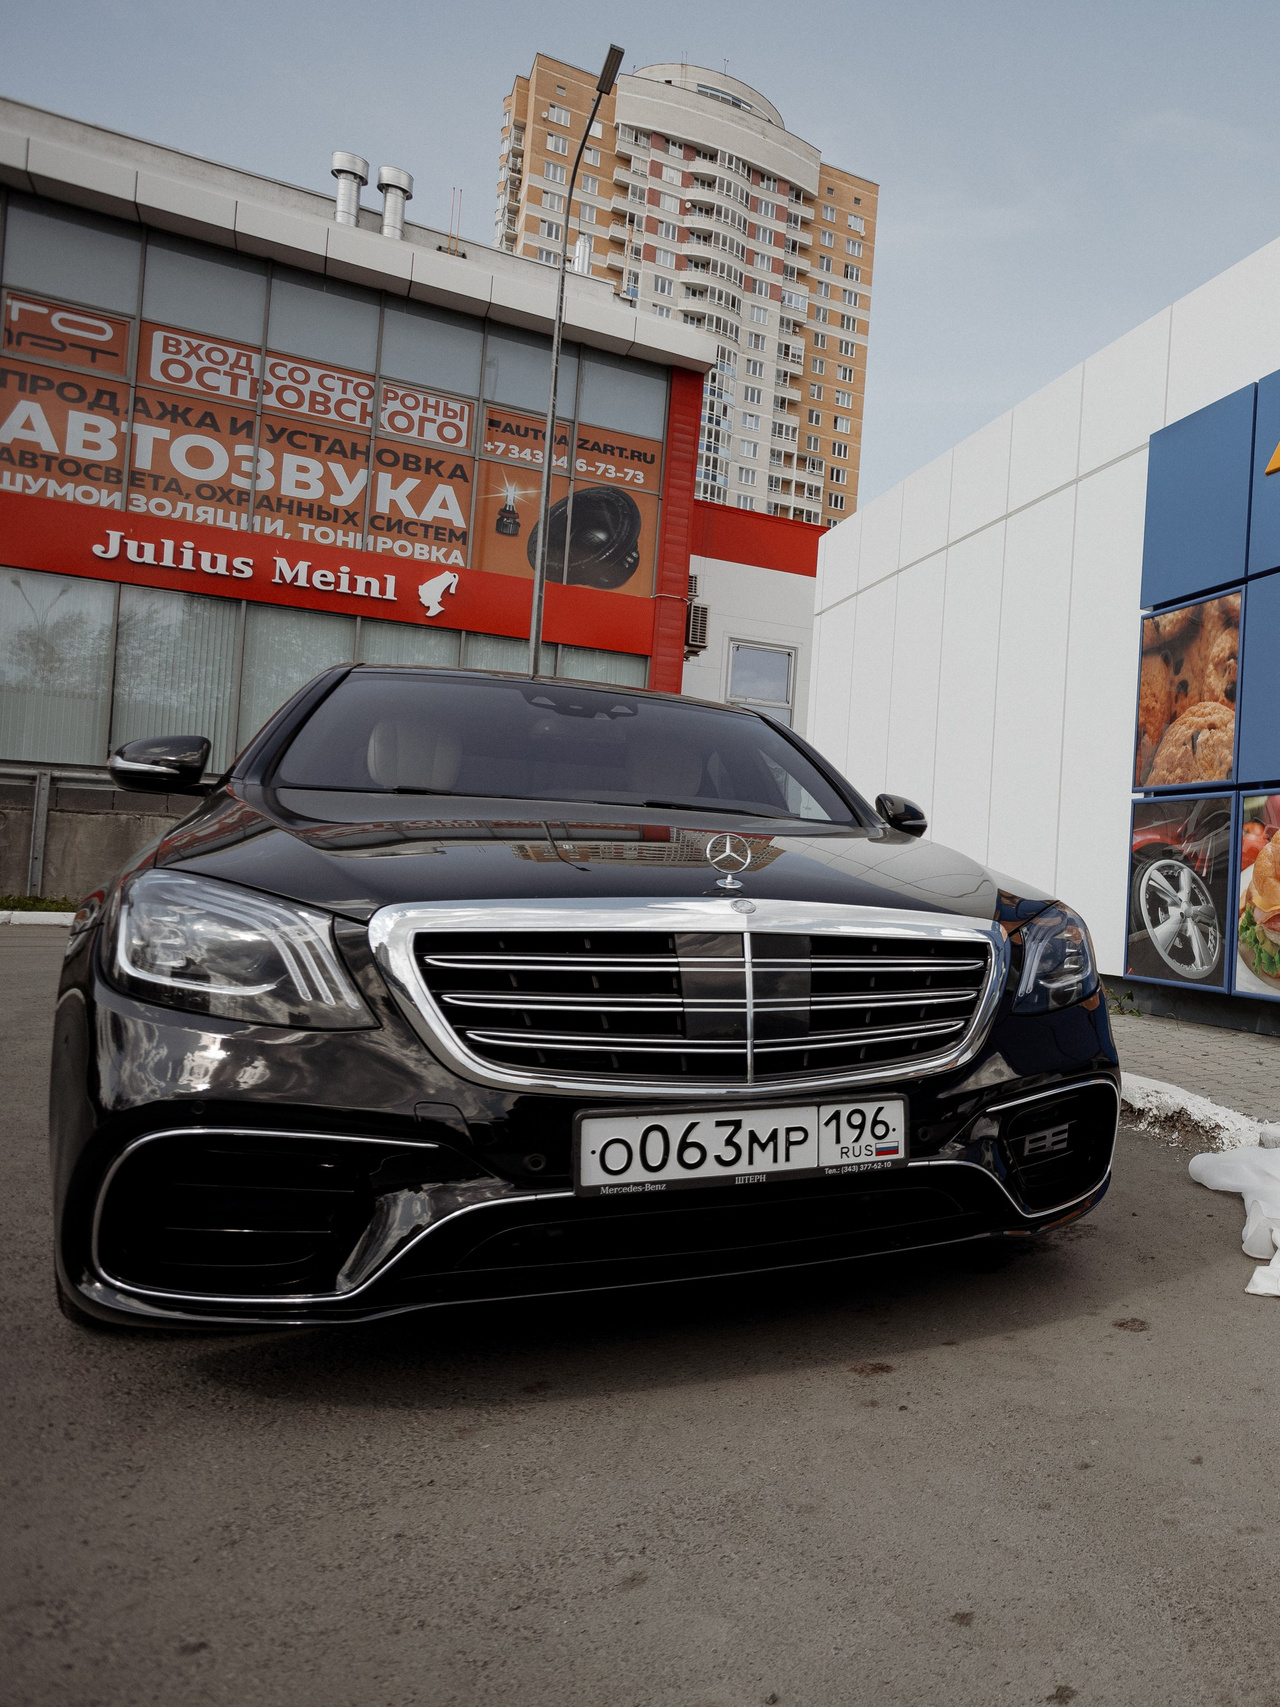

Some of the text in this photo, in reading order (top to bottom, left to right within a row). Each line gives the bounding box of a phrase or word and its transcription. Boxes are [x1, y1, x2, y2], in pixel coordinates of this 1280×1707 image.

[160, 357, 463, 445] ОСТРОВСКОГО
[162, 334, 465, 423] ВХОД СО СТОРОНЫ
[0, 367, 470, 484] ПРОДАЖА И УСТАНОВКА
[0, 399, 467, 529] АВТОЗВУКА
[0, 446, 468, 546] АВТОСВЕТА, ОХРАННЫХ СИСТЕМ
[92, 529, 398, 602] Julius Meinl
[298, 522, 465, 567] ТОНИРОВКА
[822, 1105, 891, 1145] 196
[840, 1143, 874, 1160] RUS
[600, 1182, 667, 1196] Mercedes-Benz
[734, 1174, 767, 1185] ШТЕРН
